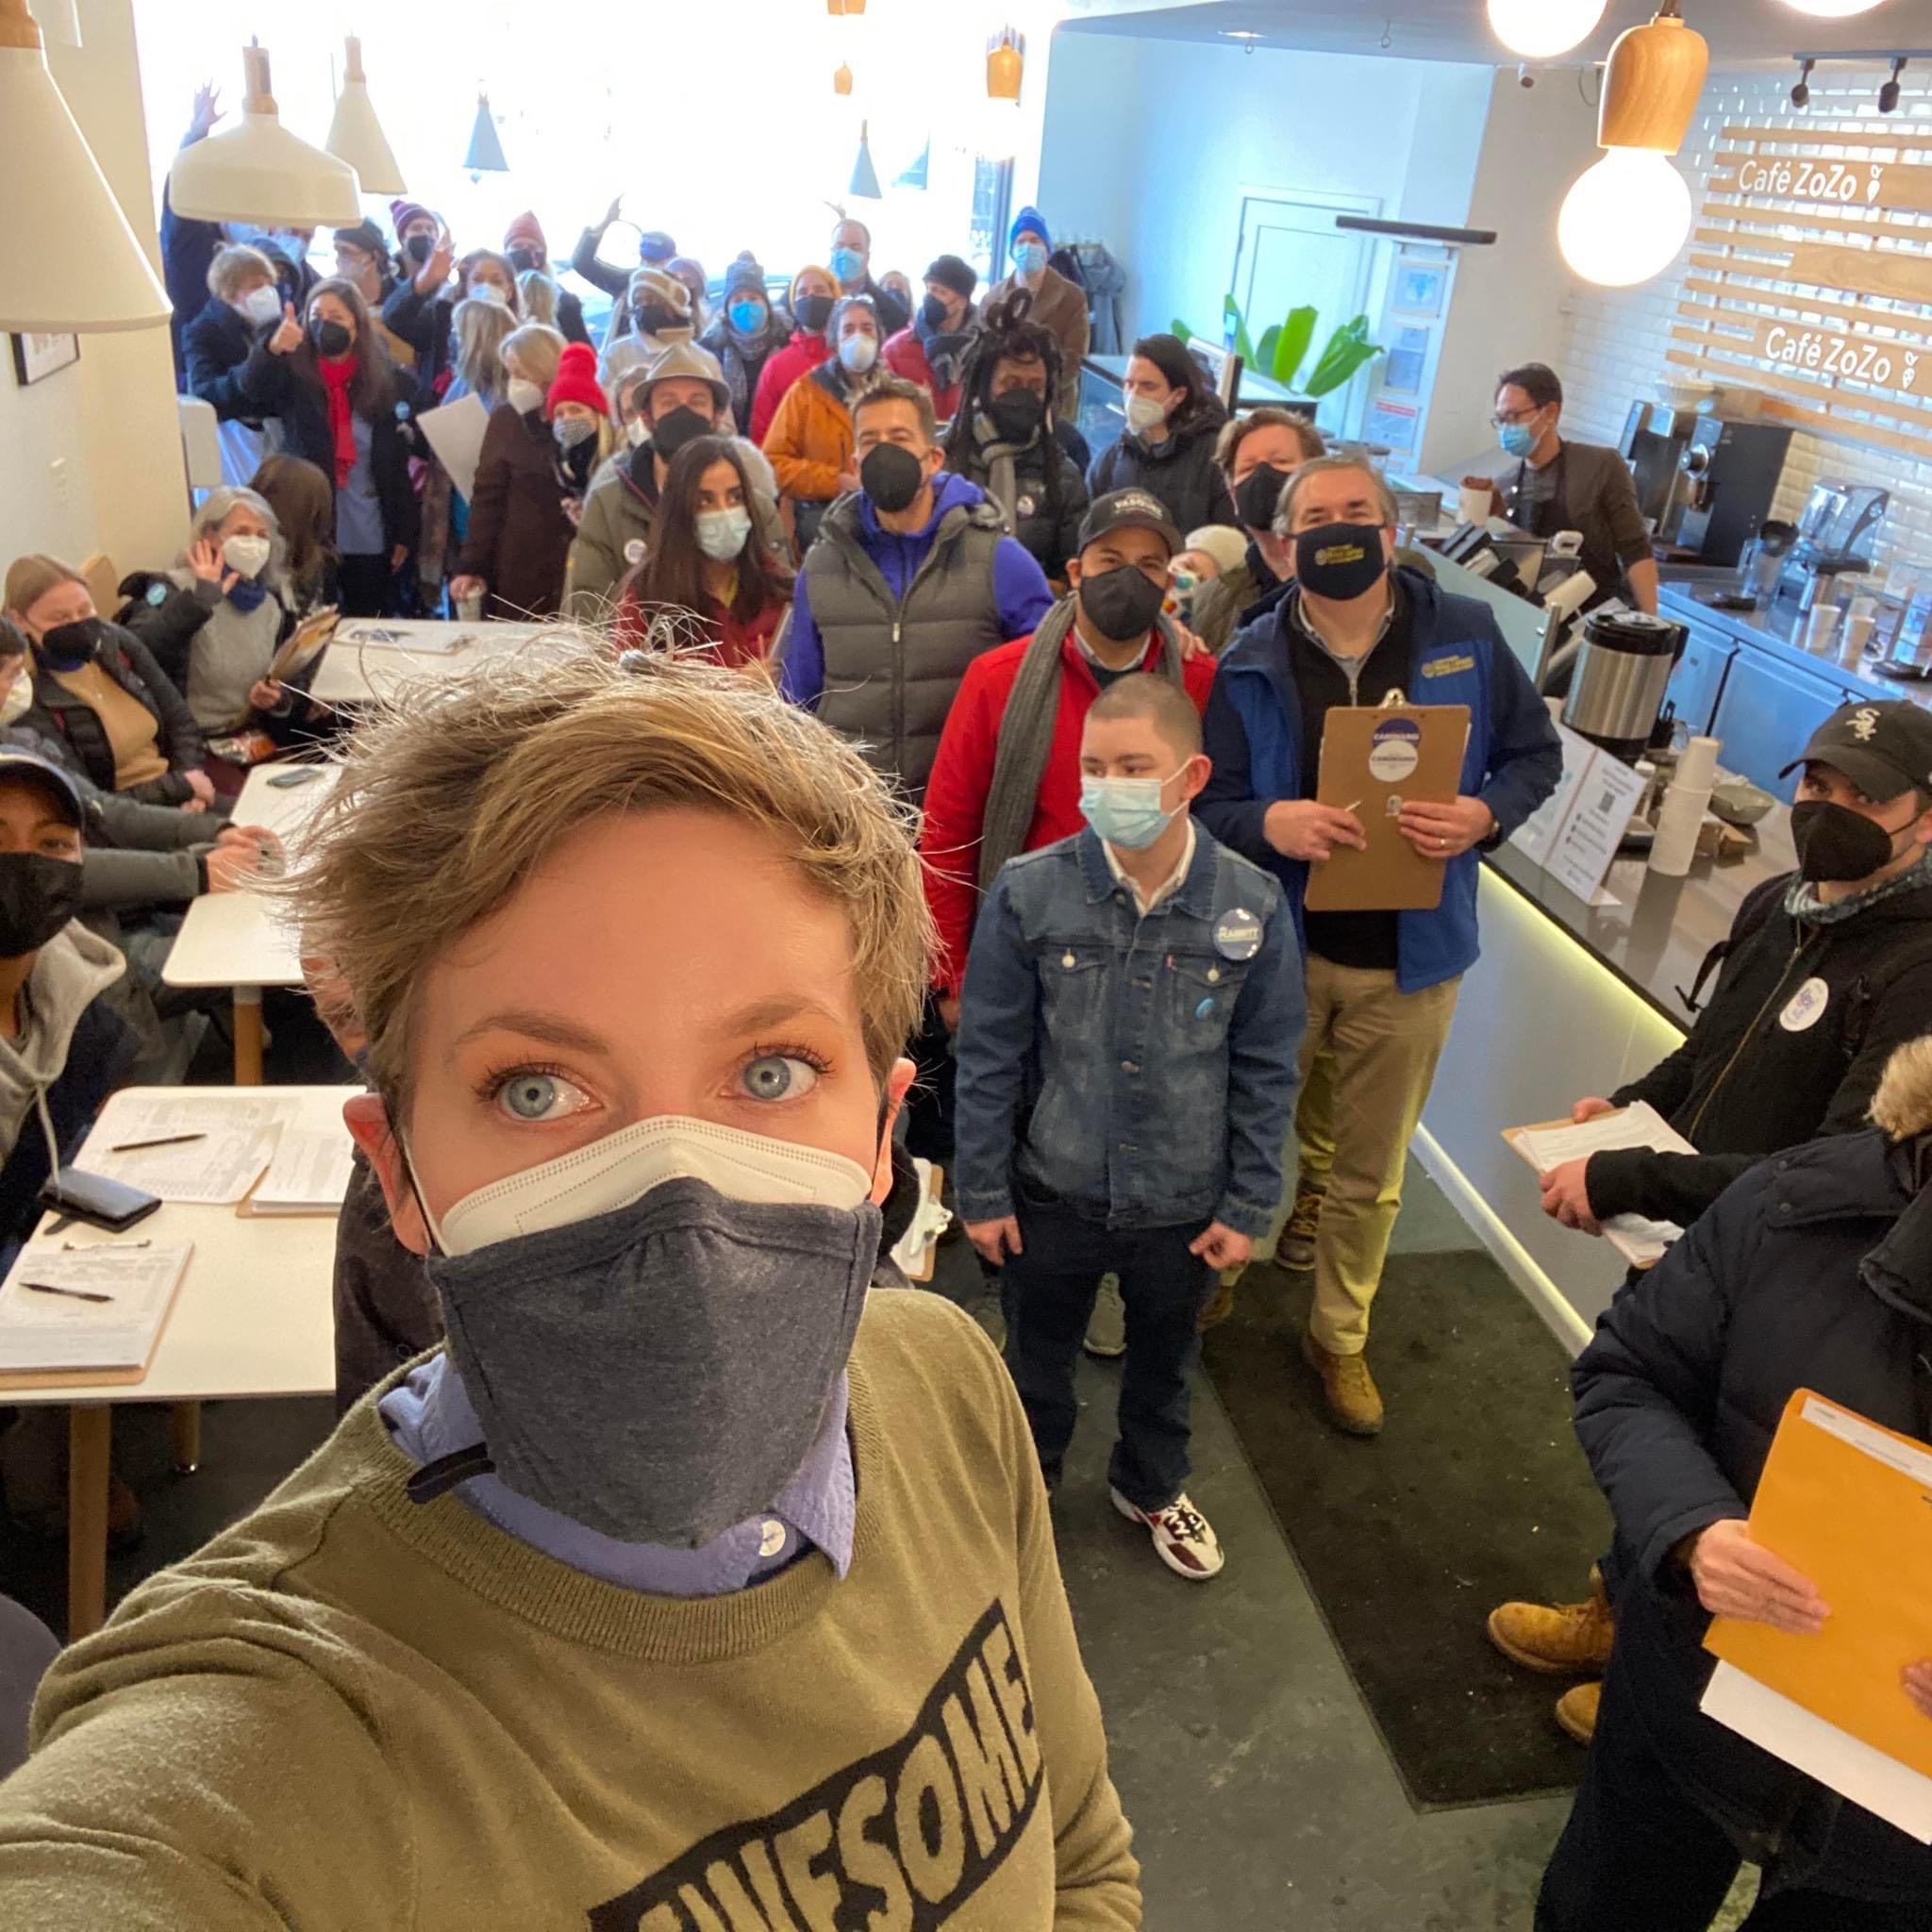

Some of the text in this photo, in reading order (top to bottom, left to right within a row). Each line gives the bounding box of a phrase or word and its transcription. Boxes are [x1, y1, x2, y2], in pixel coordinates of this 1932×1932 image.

[1739, 159, 1857, 201] Café ZoZo
[1765, 326, 1891, 383] Café ZoZo
[638, 1621, 1041, 1932] ESOME
